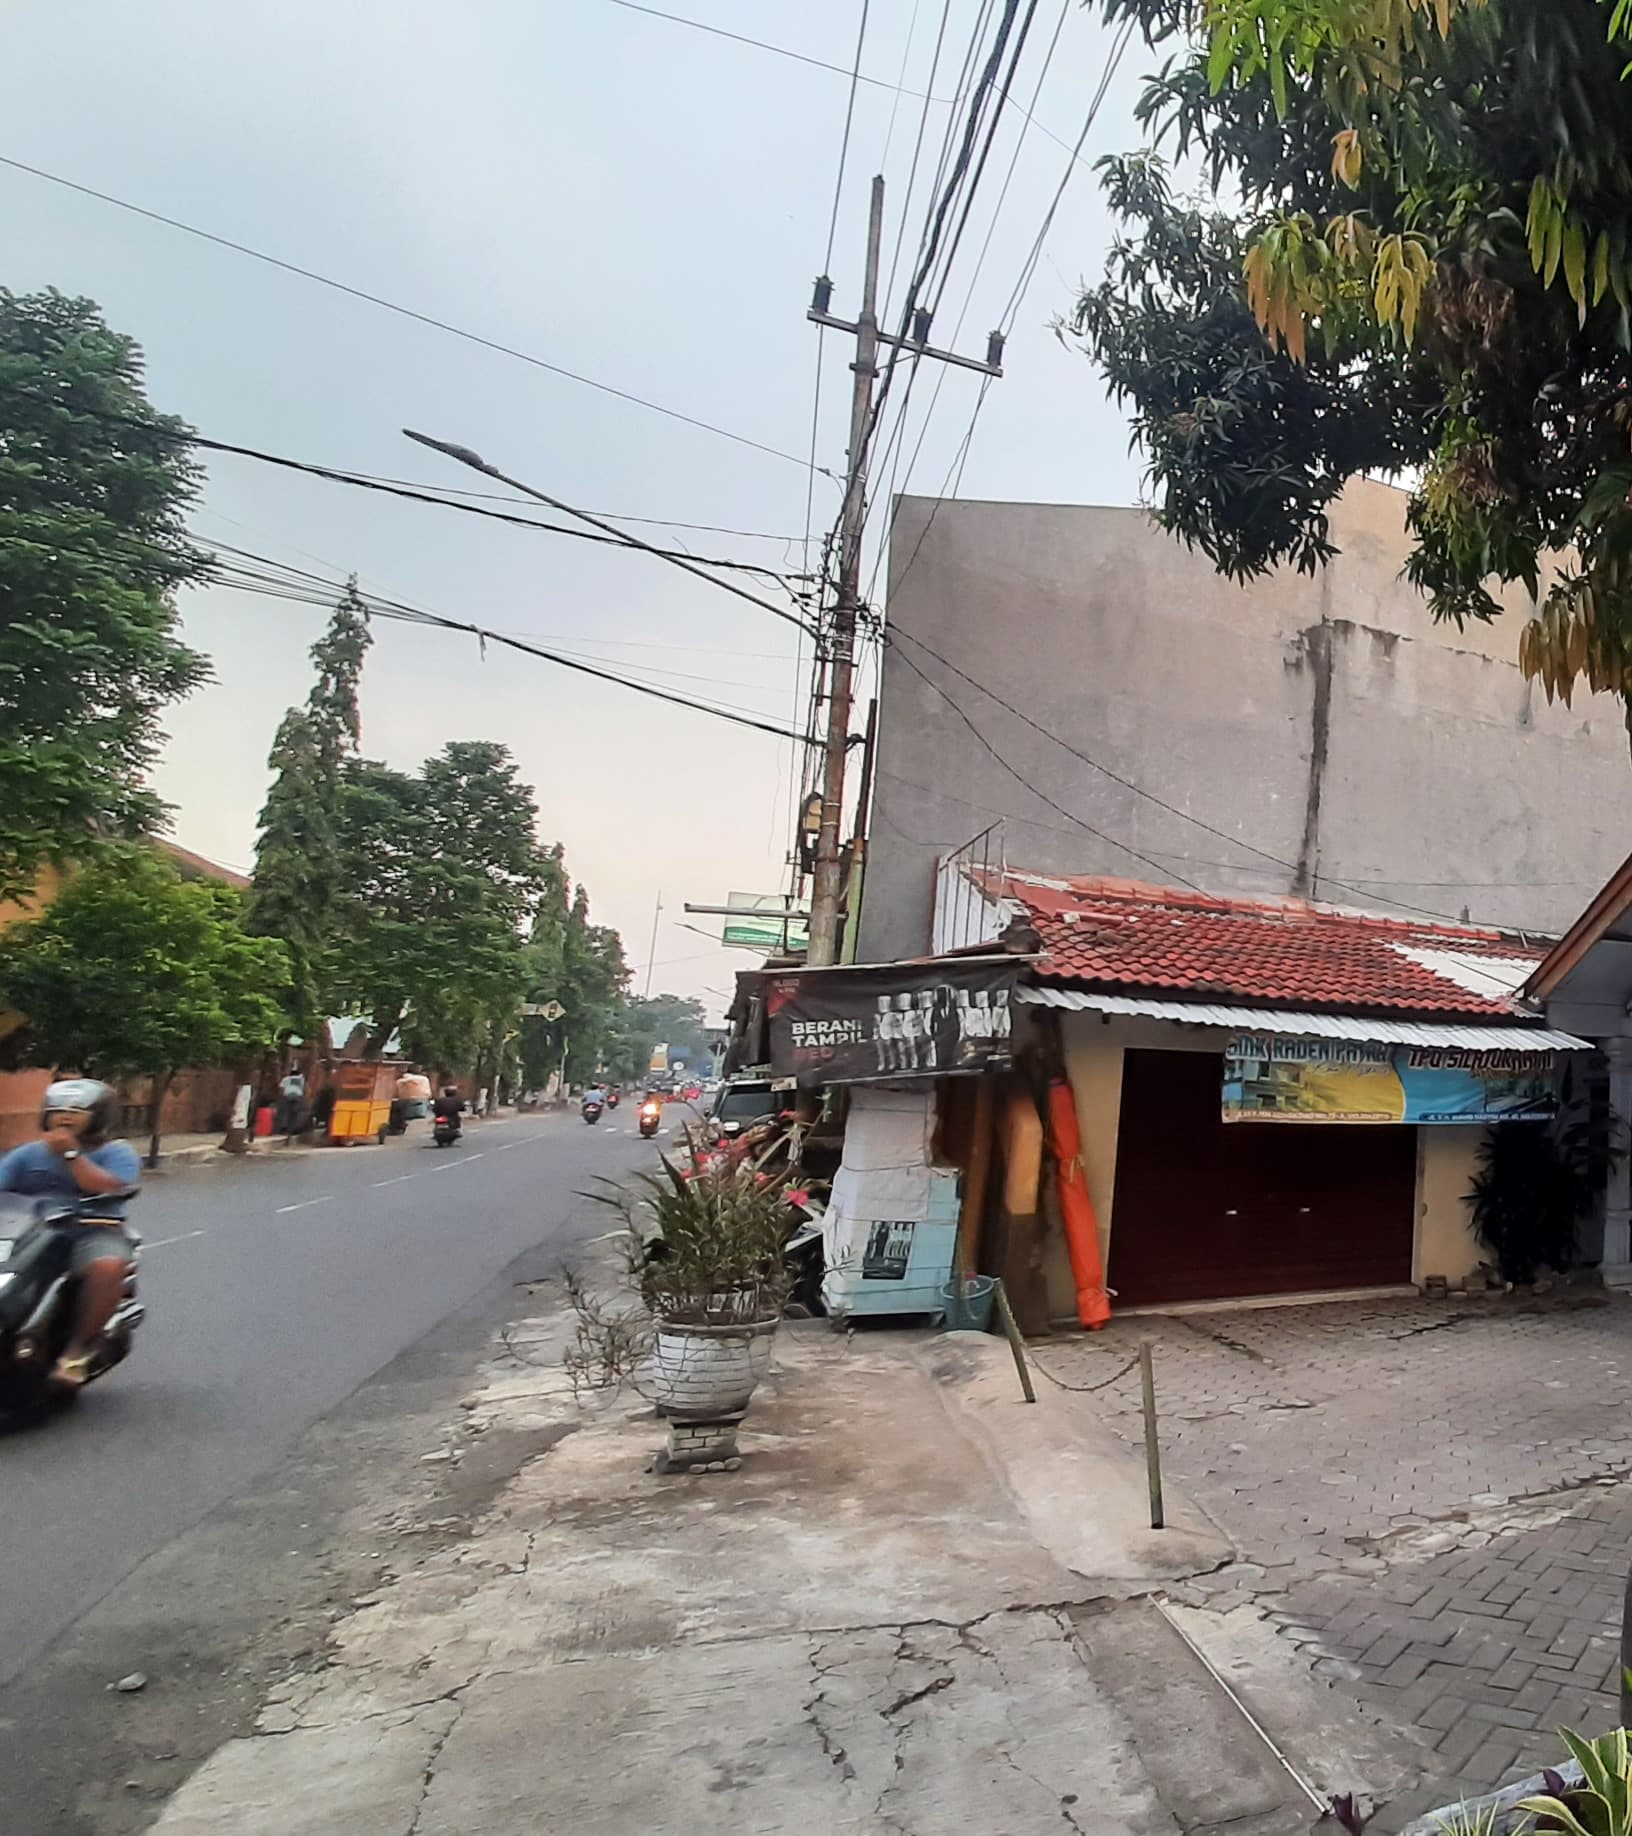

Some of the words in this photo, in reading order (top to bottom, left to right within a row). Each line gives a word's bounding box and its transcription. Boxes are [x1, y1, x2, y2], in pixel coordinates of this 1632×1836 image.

[791, 1018, 862, 1035] BERANI
[791, 1030, 868, 1048] TAMPIL
[1271, 1037, 1331, 1062] RADEN
